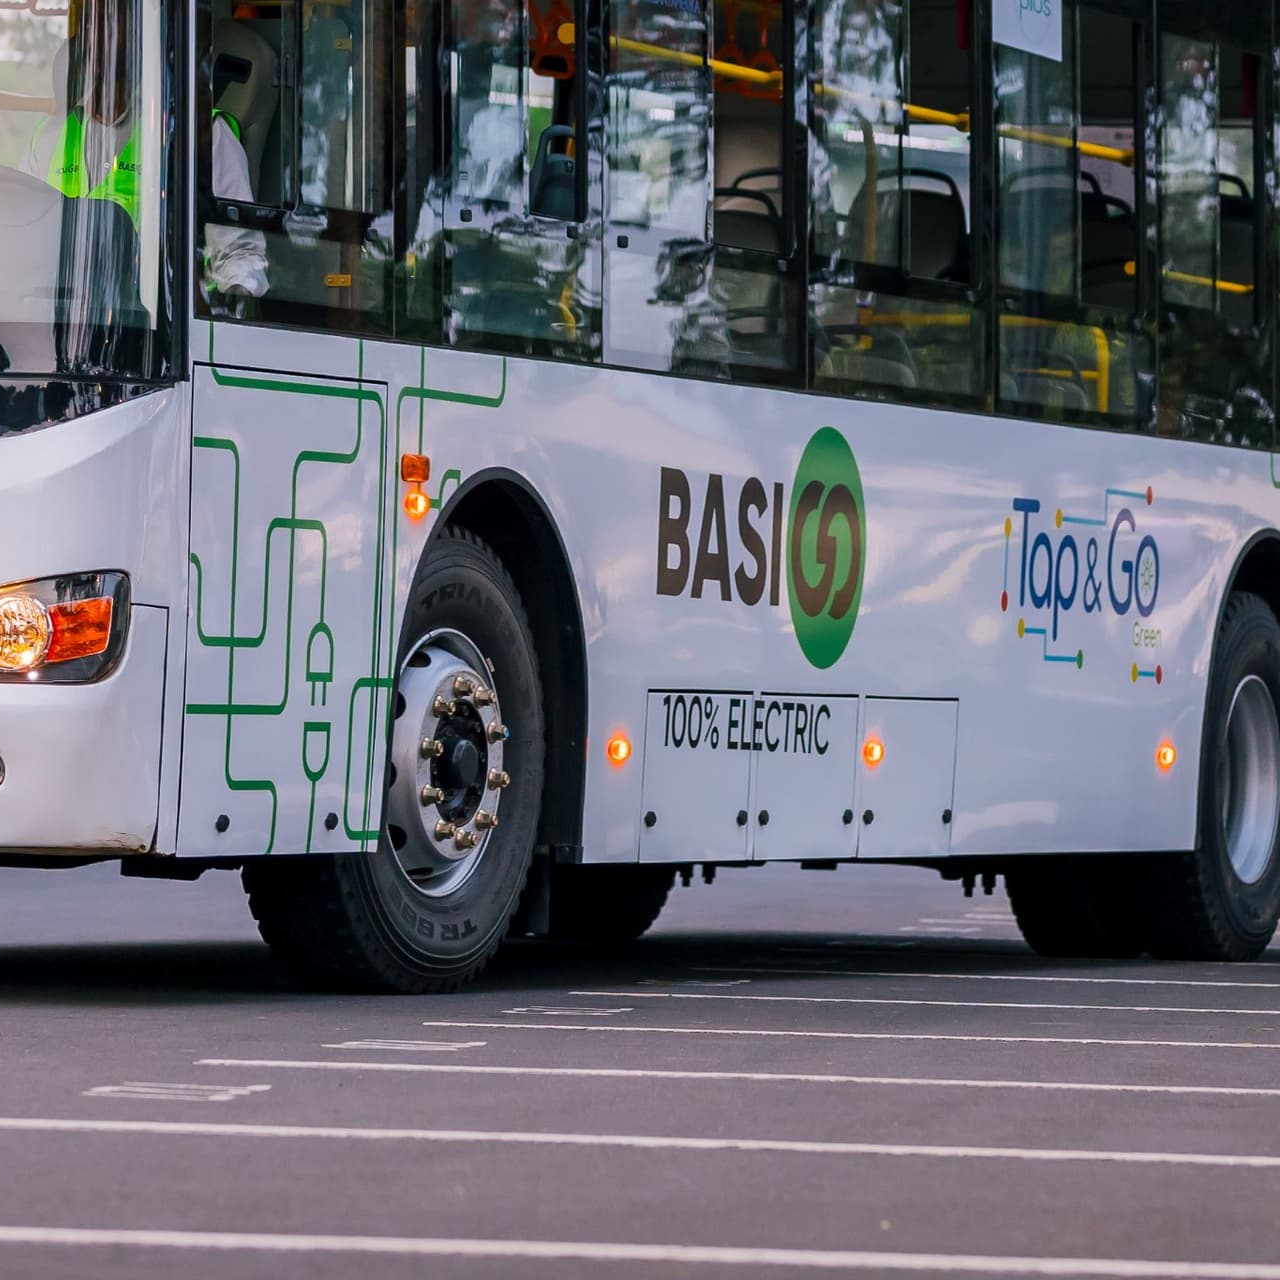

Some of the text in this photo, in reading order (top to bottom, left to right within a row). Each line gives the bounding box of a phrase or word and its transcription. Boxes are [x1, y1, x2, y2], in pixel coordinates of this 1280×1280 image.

[1132, 621, 1163, 648] Green
[663, 694, 831, 756] 100% ELECTRIC
